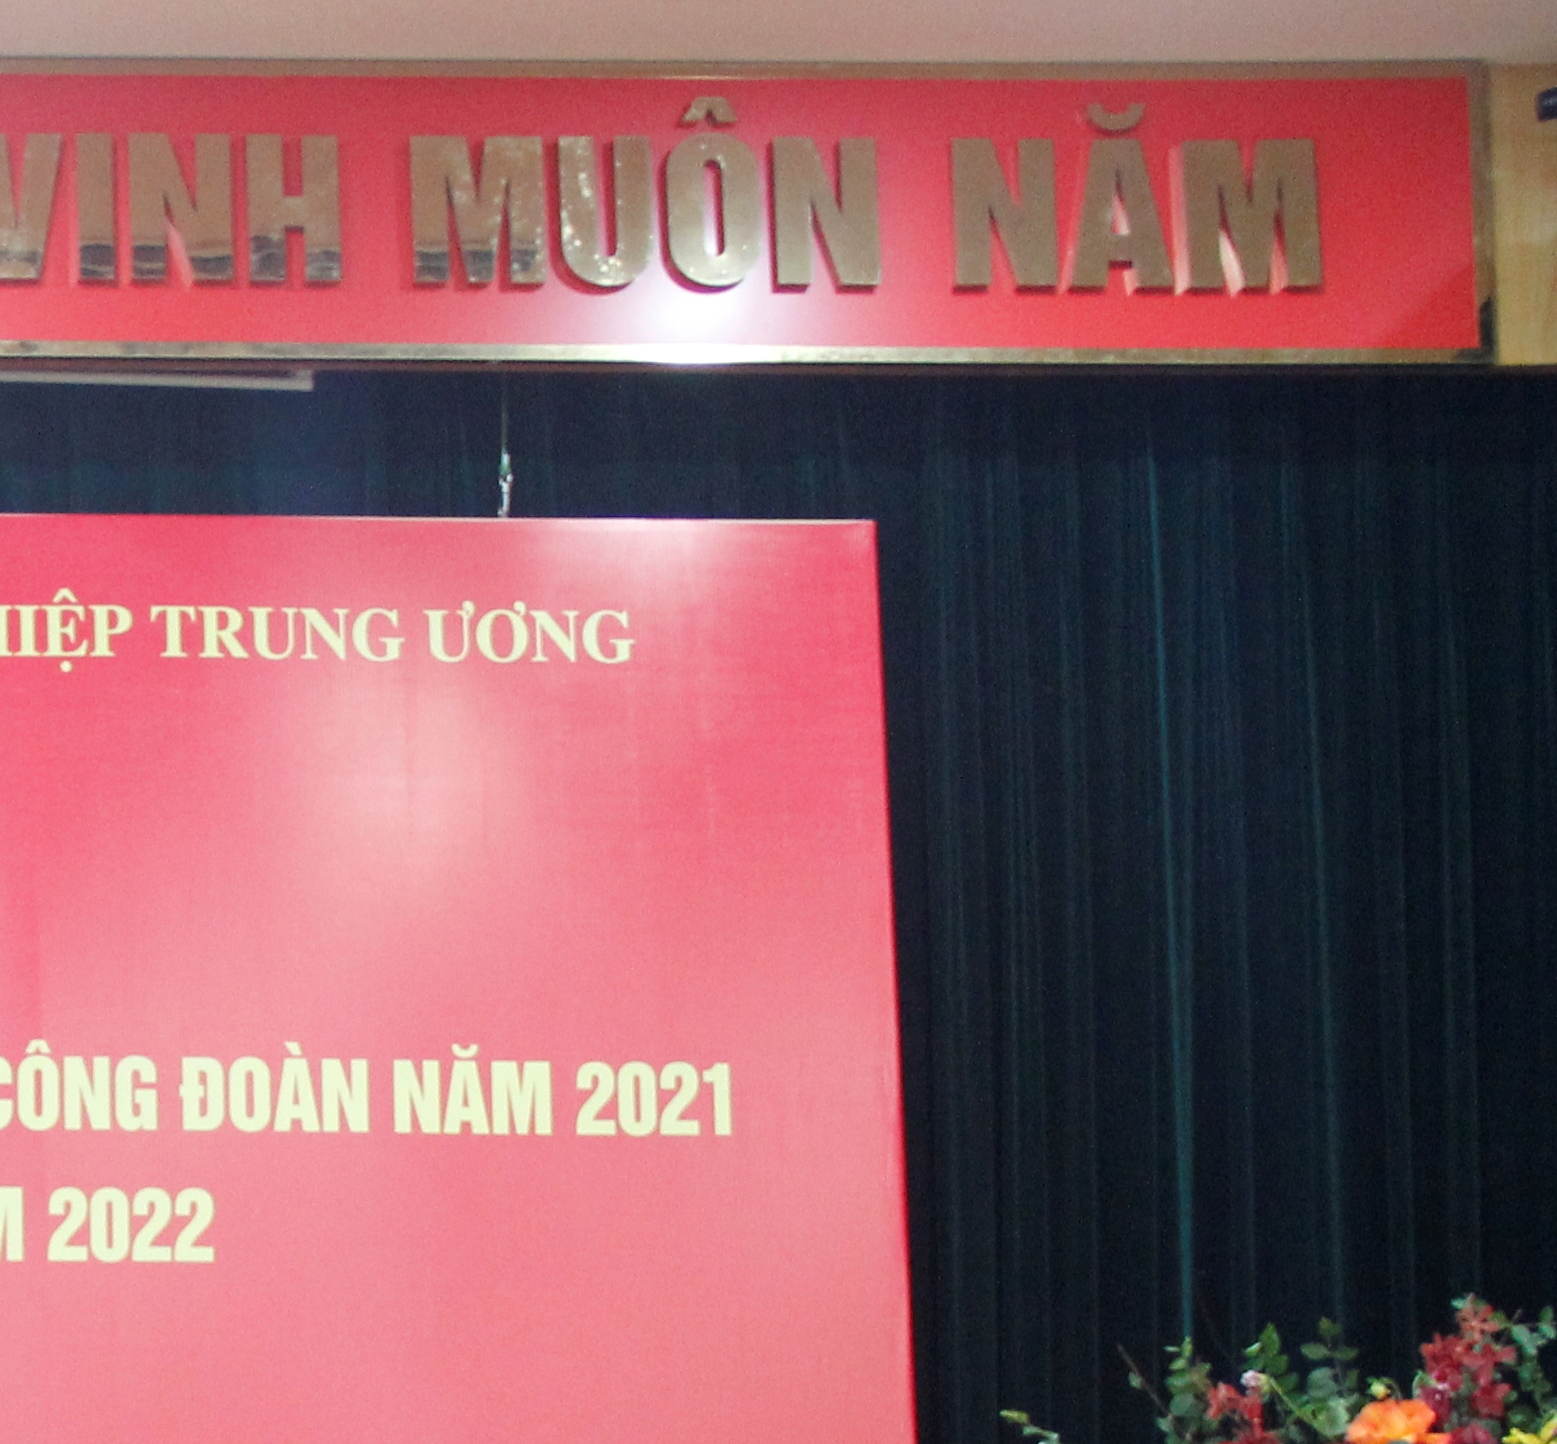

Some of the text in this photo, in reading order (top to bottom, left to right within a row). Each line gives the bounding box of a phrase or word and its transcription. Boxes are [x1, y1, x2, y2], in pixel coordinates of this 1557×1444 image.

[407, 95, 883, 290] MUÔN
[949, 100, 1324, 292] NĂM
[149, 604, 405, 664] TRUNG
[423, 599, 636, 665] ƯƠNG
[176, 1039, 372, 1135] ĐOÀN
[391, 1042, 555, 1138] NĂM
[574, 1059, 734, 1139] 2021
[45, 1184, 217, 1265] 2022
